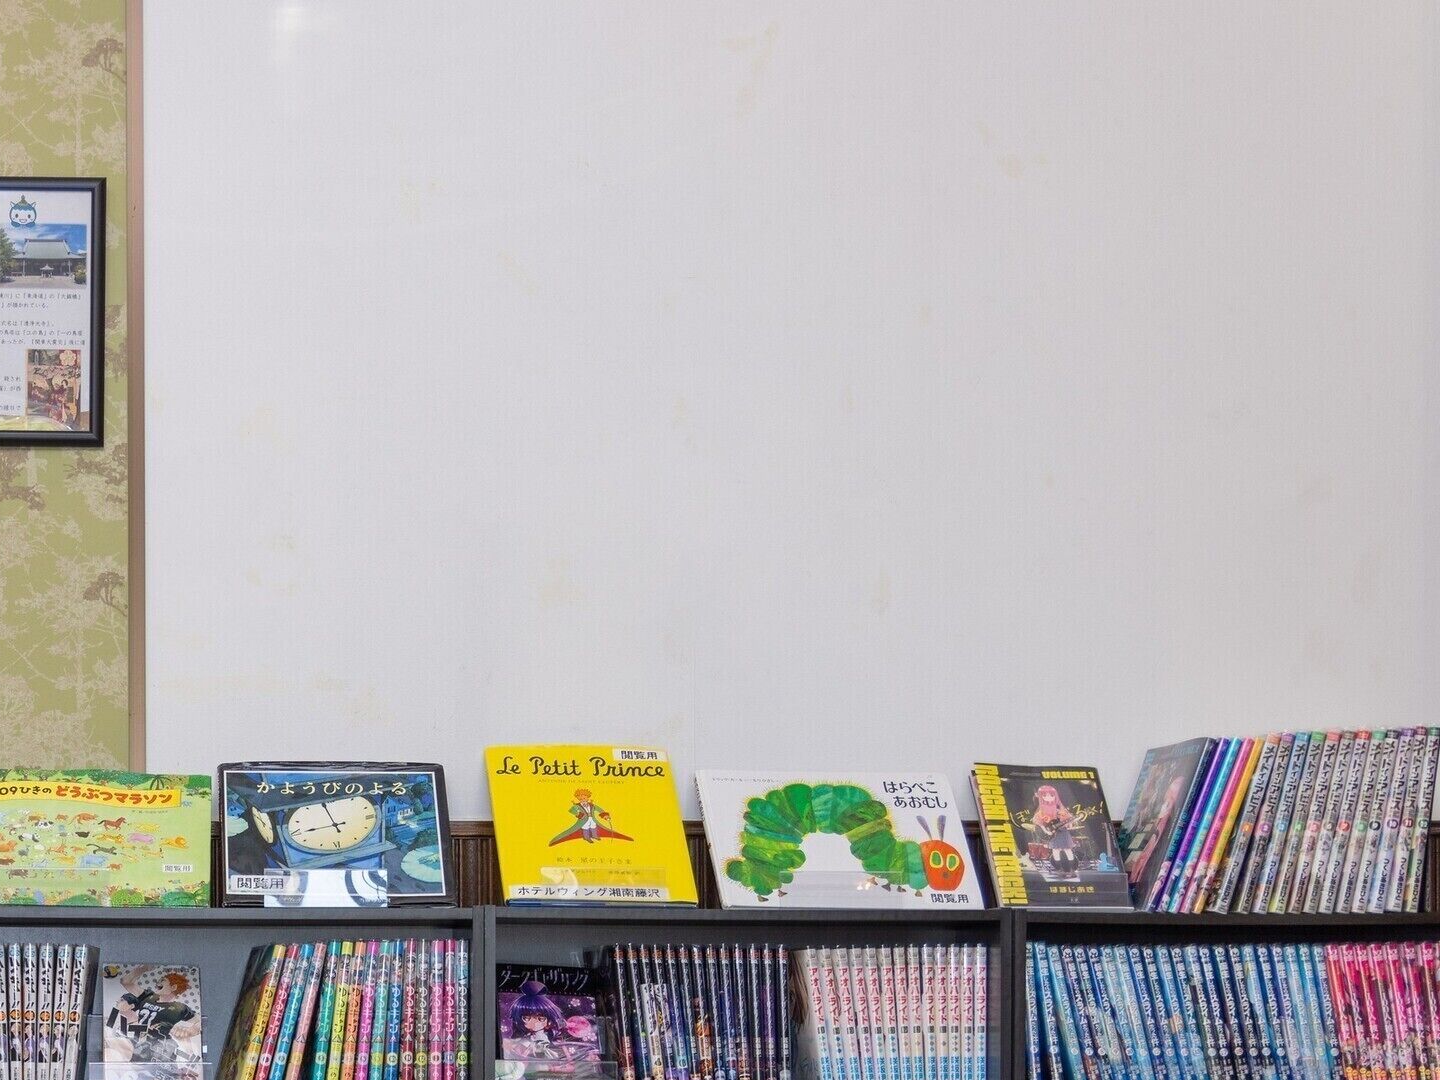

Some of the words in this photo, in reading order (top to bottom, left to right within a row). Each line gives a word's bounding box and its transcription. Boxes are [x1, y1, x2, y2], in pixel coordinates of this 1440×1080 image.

[620, 751, 658, 760] 閲覧用
[496, 756, 521, 775] Le
[529, 756, 581, 776] Petit
[589, 756, 665, 777] Prince
[257, 782, 407, 796] かようびのよる
[883, 781, 938, 794] はらぺこ
[56, 785, 173, 805] どうぶつマラソン
[893, 795, 948, 809] あおむし
[237, 878, 284, 889] 閲覧用
[517, 887, 660, 898] ホテルウィング湘南藤沢
[930, 893, 969, 904] 閲覧用
[499, 969, 589, 990] ダークギャザリング
[810, 968, 825, 1022] アオハライド
[840, 968, 854, 1024] アオハライド
